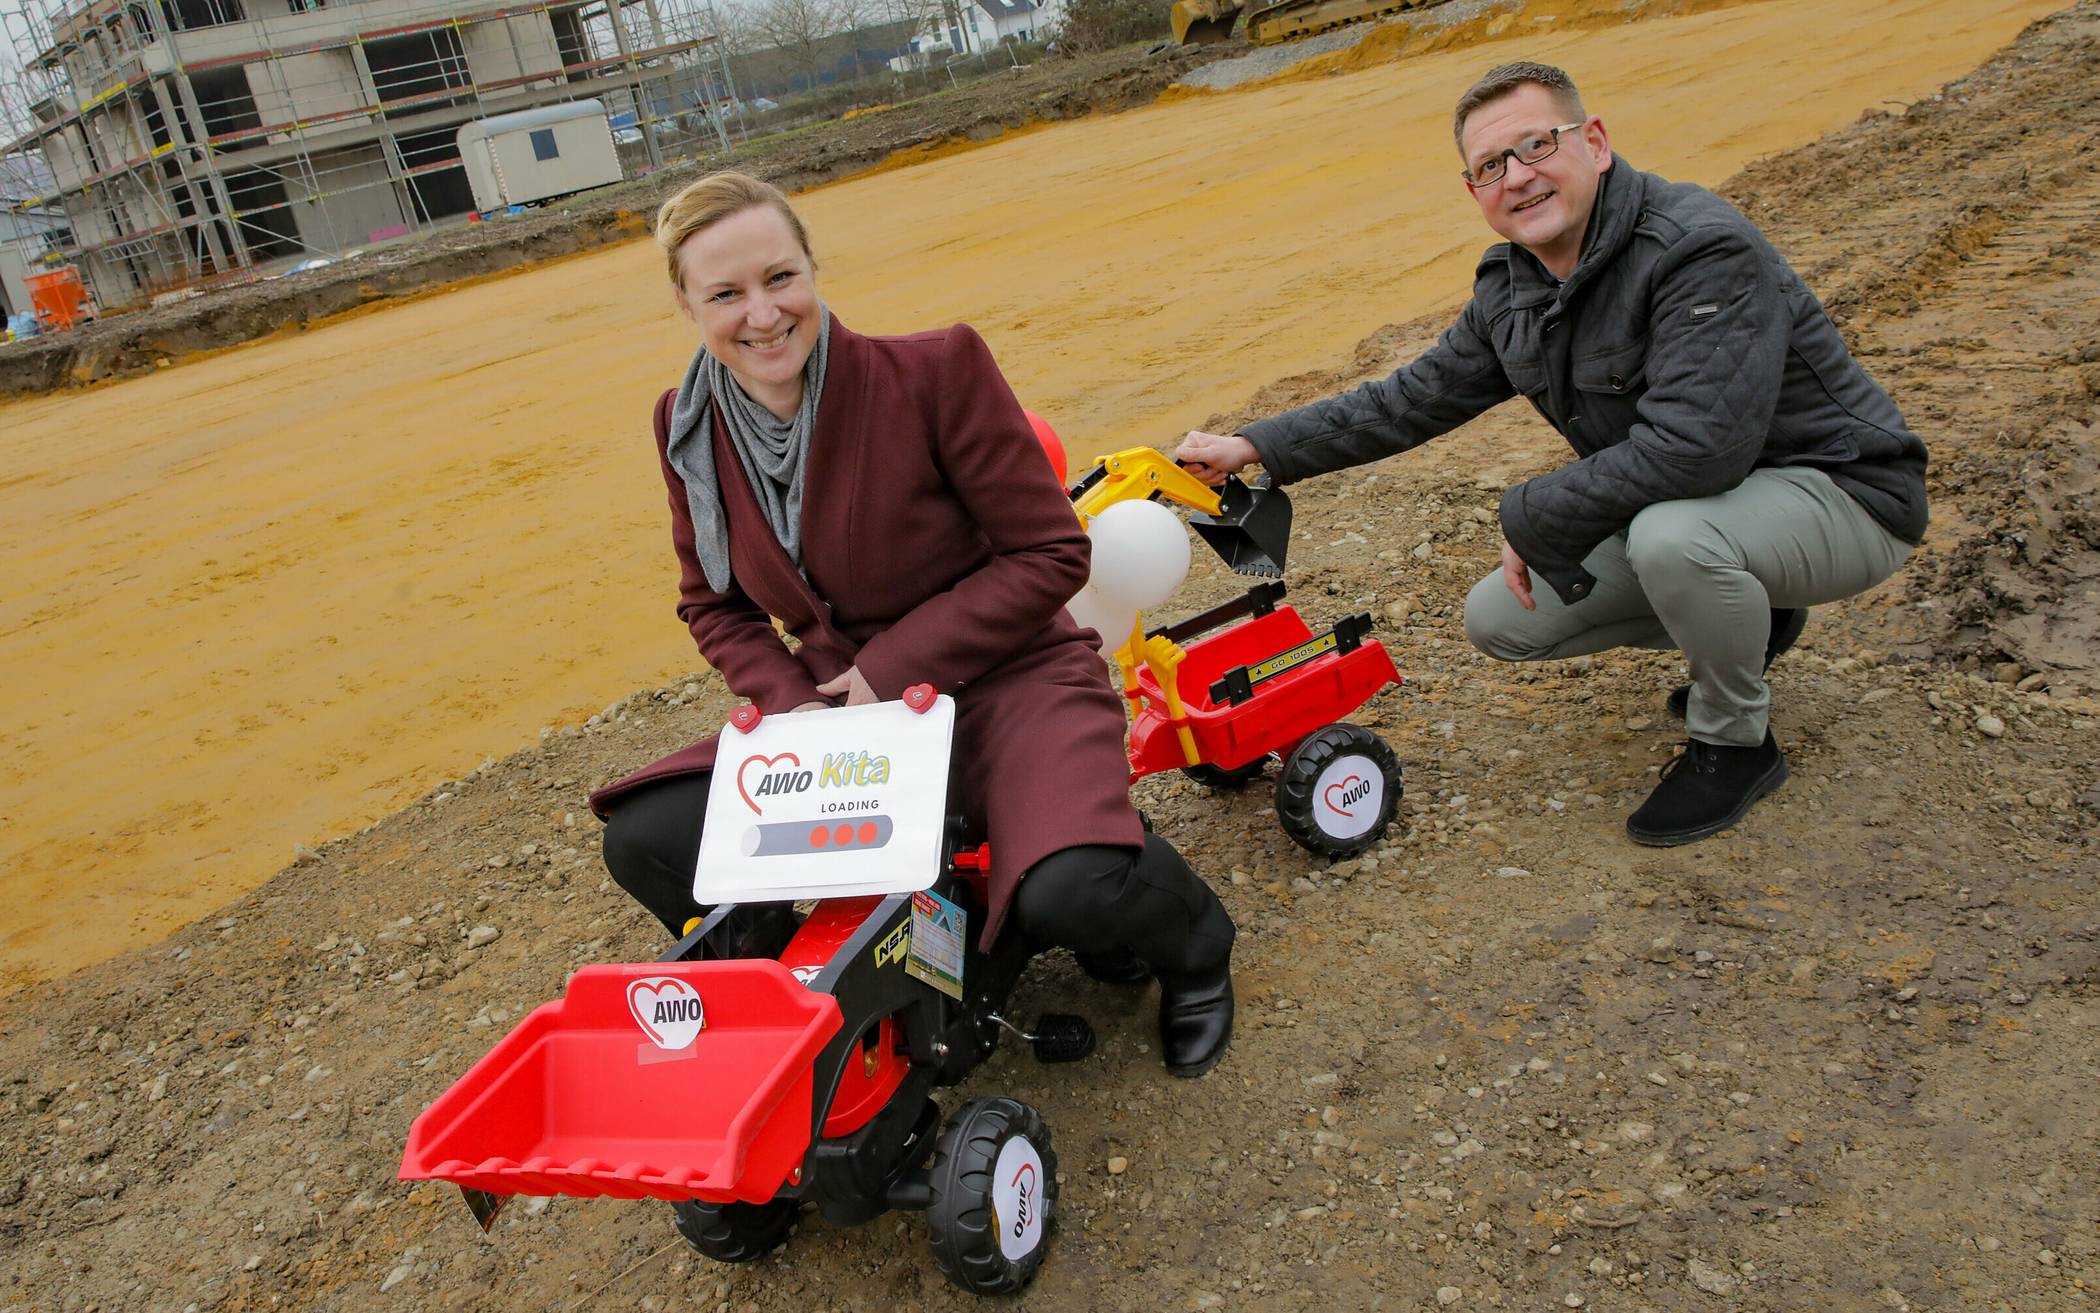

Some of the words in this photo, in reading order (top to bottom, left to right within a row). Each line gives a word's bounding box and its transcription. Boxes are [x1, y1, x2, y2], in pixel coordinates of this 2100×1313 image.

[755, 770, 813, 797] AWO
[818, 750, 891, 789] Kita
[821, 799, 880, 813] LOADING
[1343, 779, 1370, 808] AWO
[653, 998, 702, 1024] AWO
[1014, 1179, 1027, 1238] AWO
